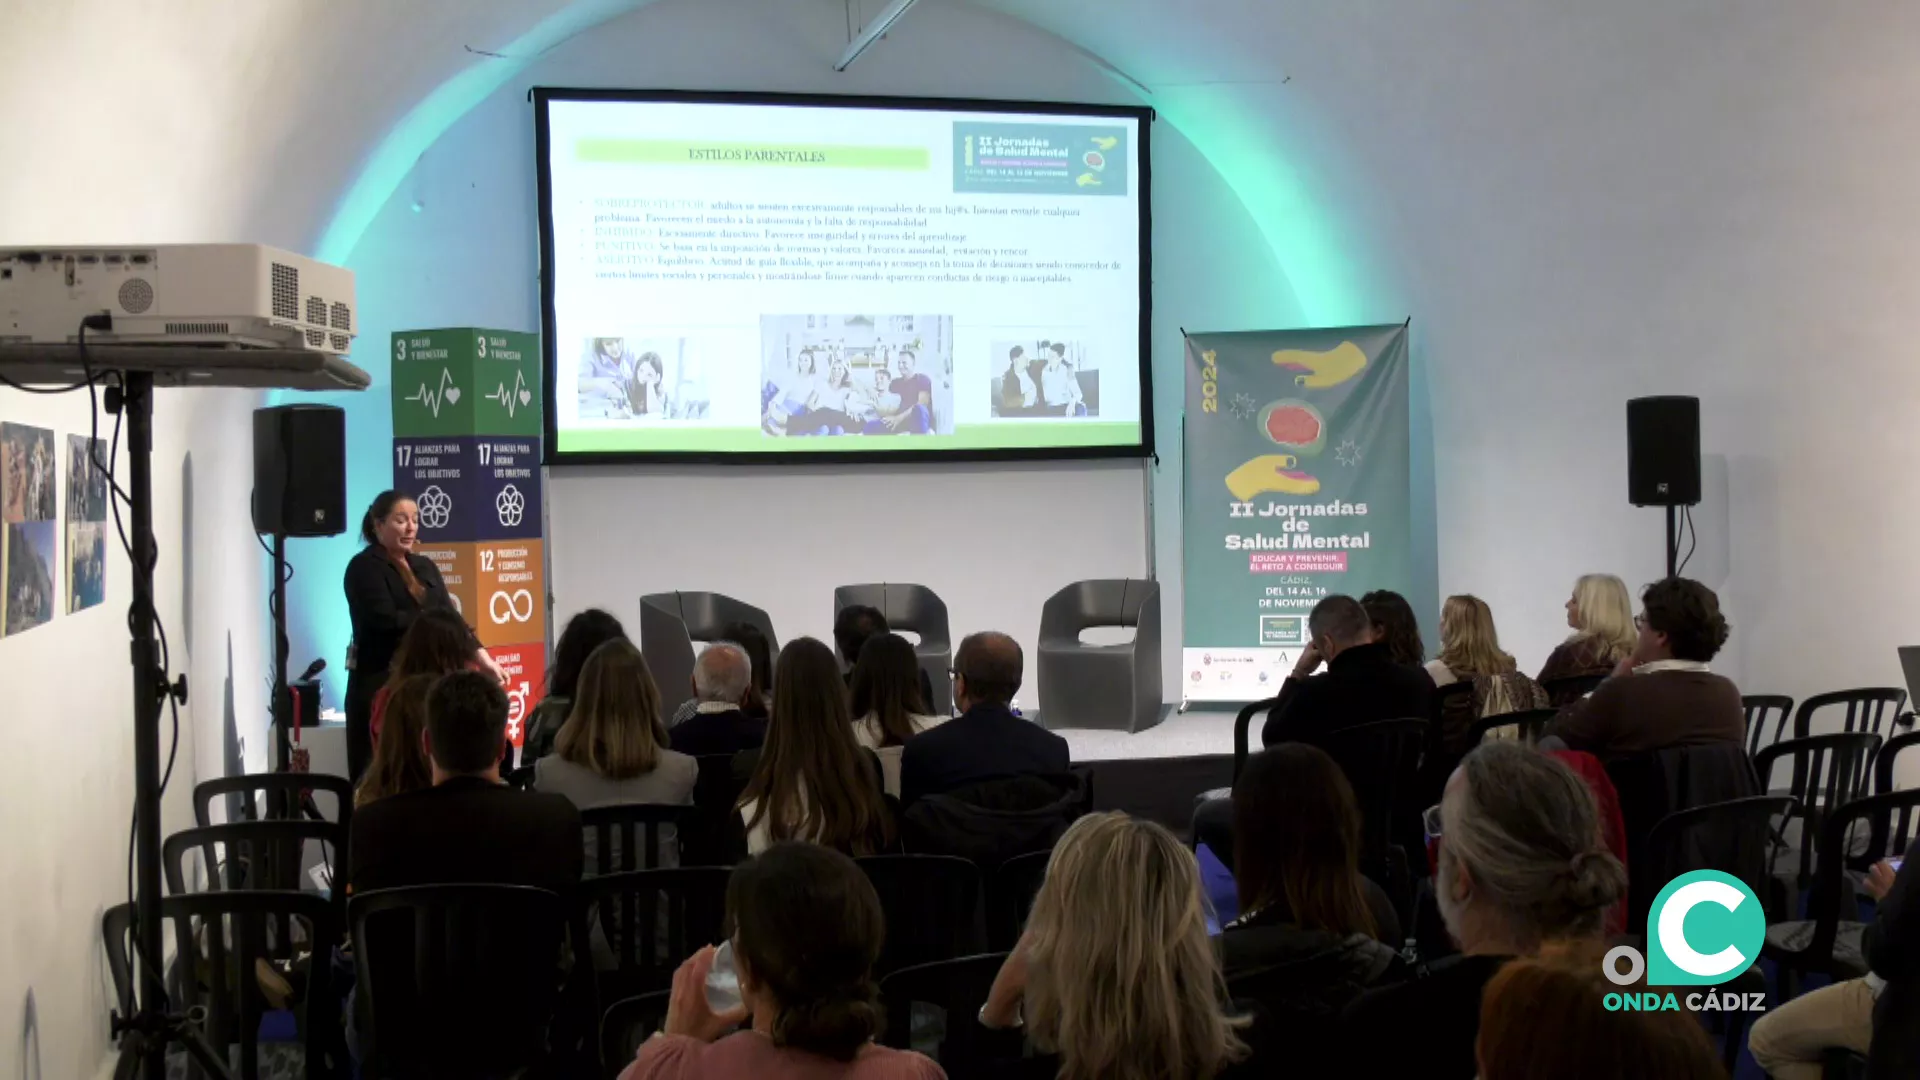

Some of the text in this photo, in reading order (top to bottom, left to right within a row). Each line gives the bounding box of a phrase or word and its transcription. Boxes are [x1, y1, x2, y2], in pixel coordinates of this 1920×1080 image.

[689, 148, 826, 162] ESTILOS PARENTALES
[995, 146, 1028, 156] Salud
[1029, 147, 1069, 157] Mental
[710, 200, 743, 211] adultos
[814, 216, 822, 225] la
[846, 216, 856, 225] de
[902, 231, 916, 240] del
[710, 242, 719, 251] la
[976, 259, 987, 268] de
[1111, 261, 1121, 269] de
[707, 271, 755, 281] personales
[886, 273, 924, 284] aparecen
[928, 272, 969, 282] conductas
[972, 273, 982, 282] de
[396, 338, 430, 361] 3 SALUD
[477, 336, 507, 358] 3 SALUD
[416, 349, 448, 360] BIENESTAR
[1202, 349, 1217, 414] 2024
[396, 444, 411, 467] 17
[444, 443, 461, 454] PARA
[477, 443, 491, 466] 17
[415, 457, 438, 467] LOGRAR
[415, 469, 427, 479] LOS
[1229, 499, 1368, 518] II Jornadas
[1282, 516, 1310, 533] de
[1224, 531, 1370, 550] Salud Mental
[480, 549, 494, 572] 12
[1252, 554, 1287, 562] EDUCAR
[1288, 554, 1295, 562] Y
[1250, 563, 1343, 571] EL RETO A CONSEGUIR
[1265, 587, 1327, 596] DEL 14 AL 16
[1258, 598, 1320, 608] DE NOVIEM
